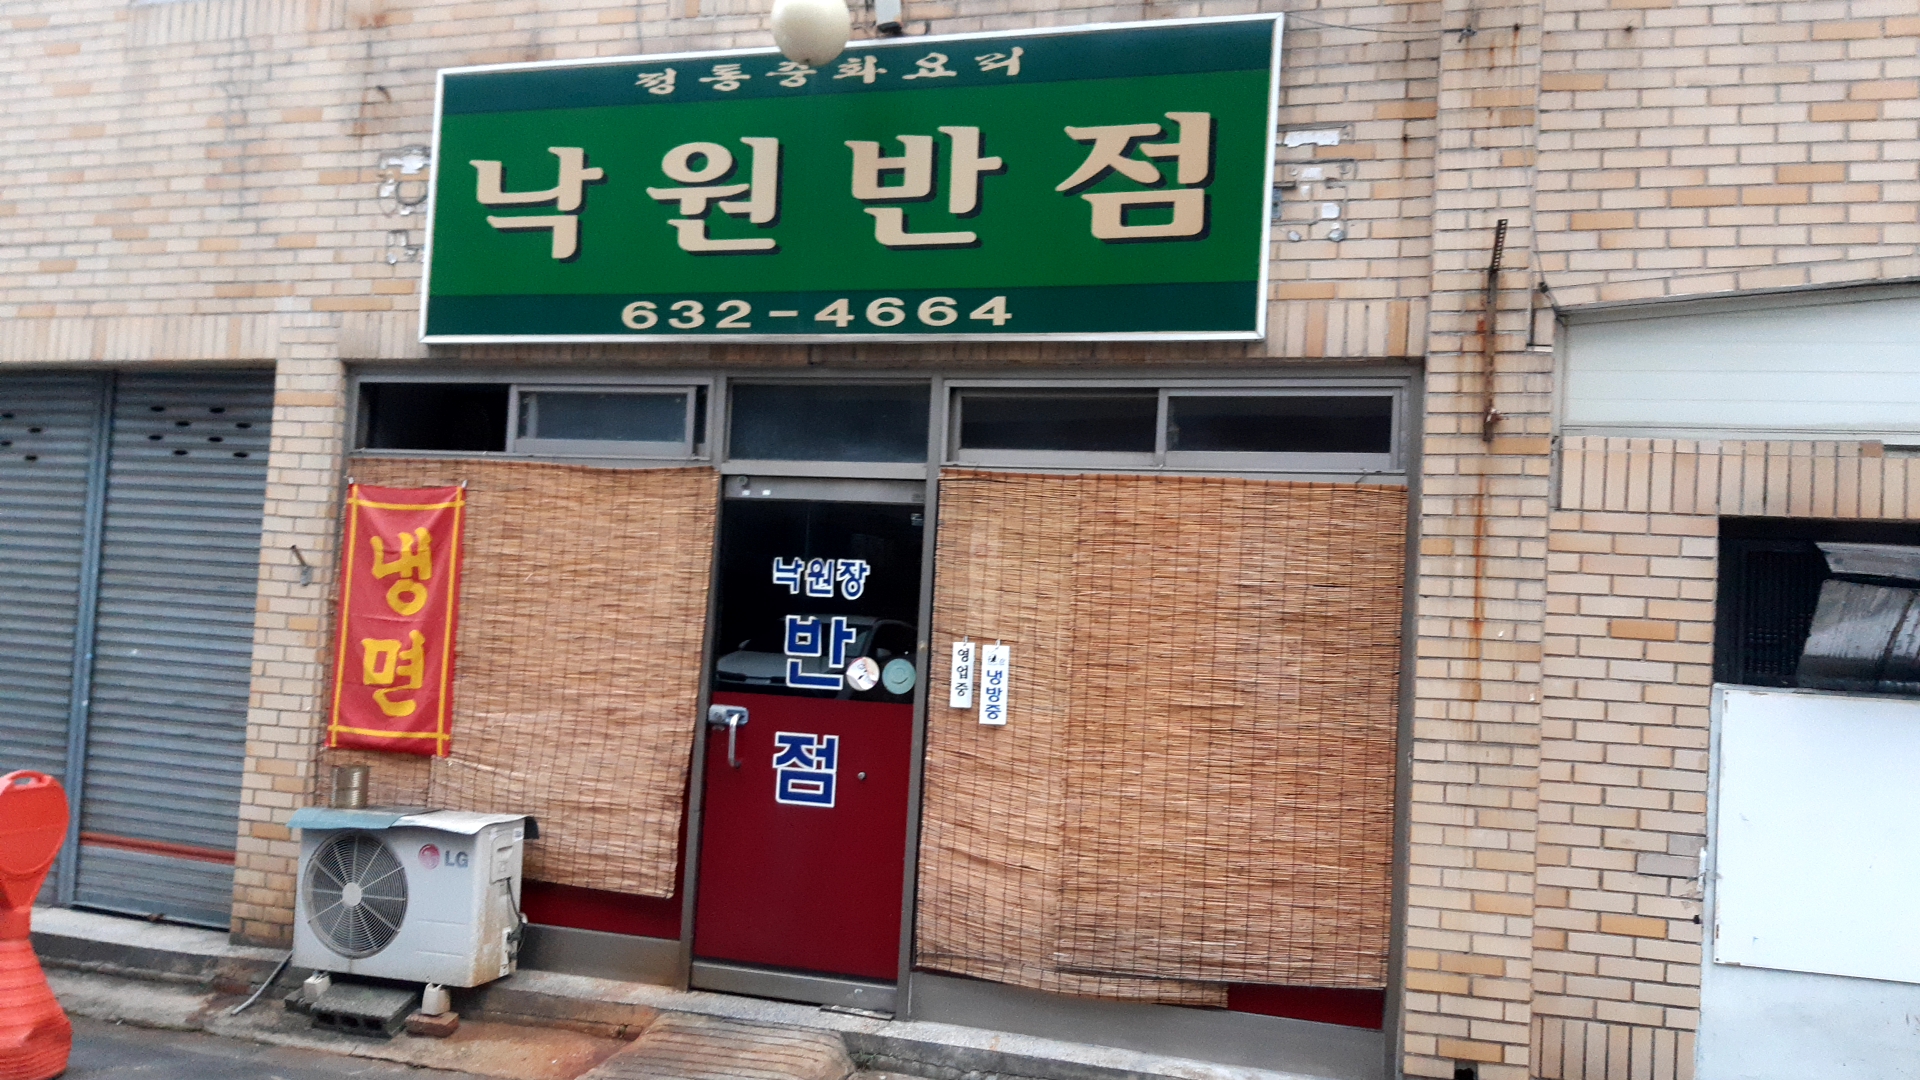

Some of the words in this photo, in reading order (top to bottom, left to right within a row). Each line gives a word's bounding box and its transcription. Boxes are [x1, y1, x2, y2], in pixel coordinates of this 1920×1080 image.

[469, 111, 1213, 262] 낙원반점
[621, 295, 1013, 330] 632-4664
[772, 556, 871, 601] 낙원장
[360, 526, 433, 718] 냉면
[954, 647, 970, 697] 영업중
[984, 669, 1003, 720] 냉방중
[444, 850, 469, 868] LG
